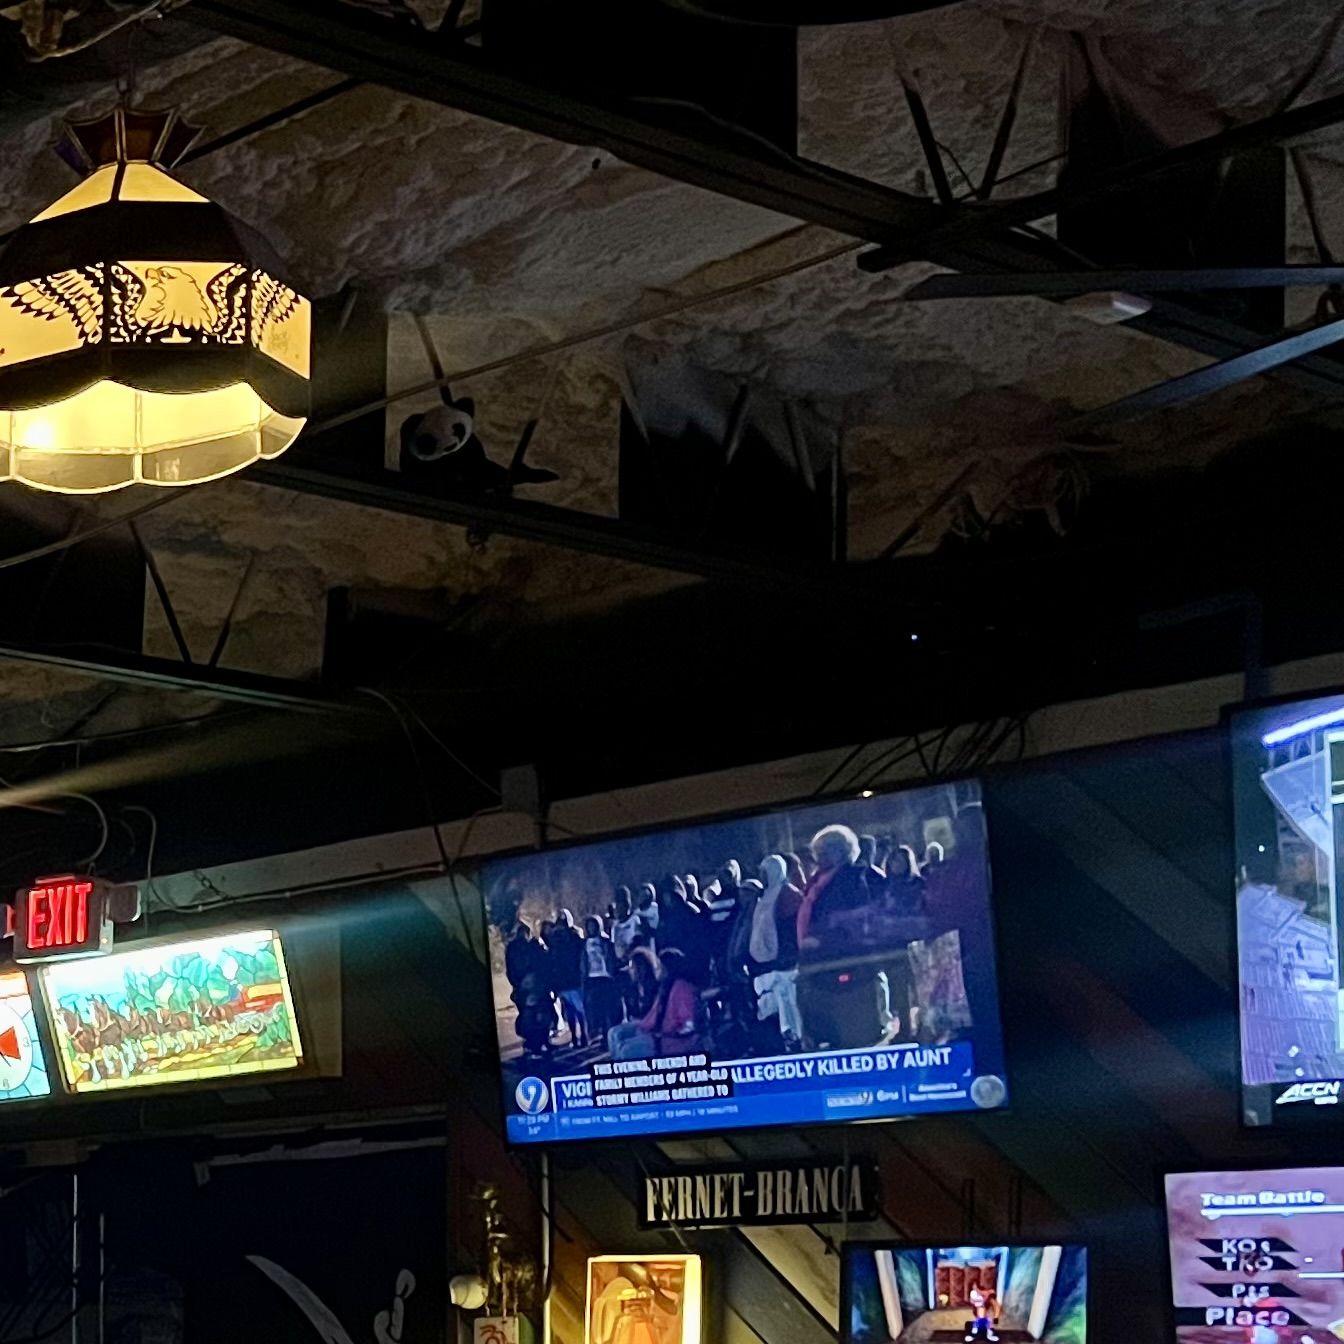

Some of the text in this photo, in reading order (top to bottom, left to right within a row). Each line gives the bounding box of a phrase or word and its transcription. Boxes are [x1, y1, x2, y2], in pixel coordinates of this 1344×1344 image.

[28, 883, 92, 948] EXIT
[817, 1055, 874, 1075] KILLED
[876, 1053, 901, 1069] BY
[903, 1047, 952, 1068] AUNT
[1275, 1081, 1340, 1104] ACCN
[645, 1165, 865, 1222] FERNET-BRANCA
[1200, 1190, 1326, 1206] Team Battle
[1205, 1307, 1289, 1326] Place
